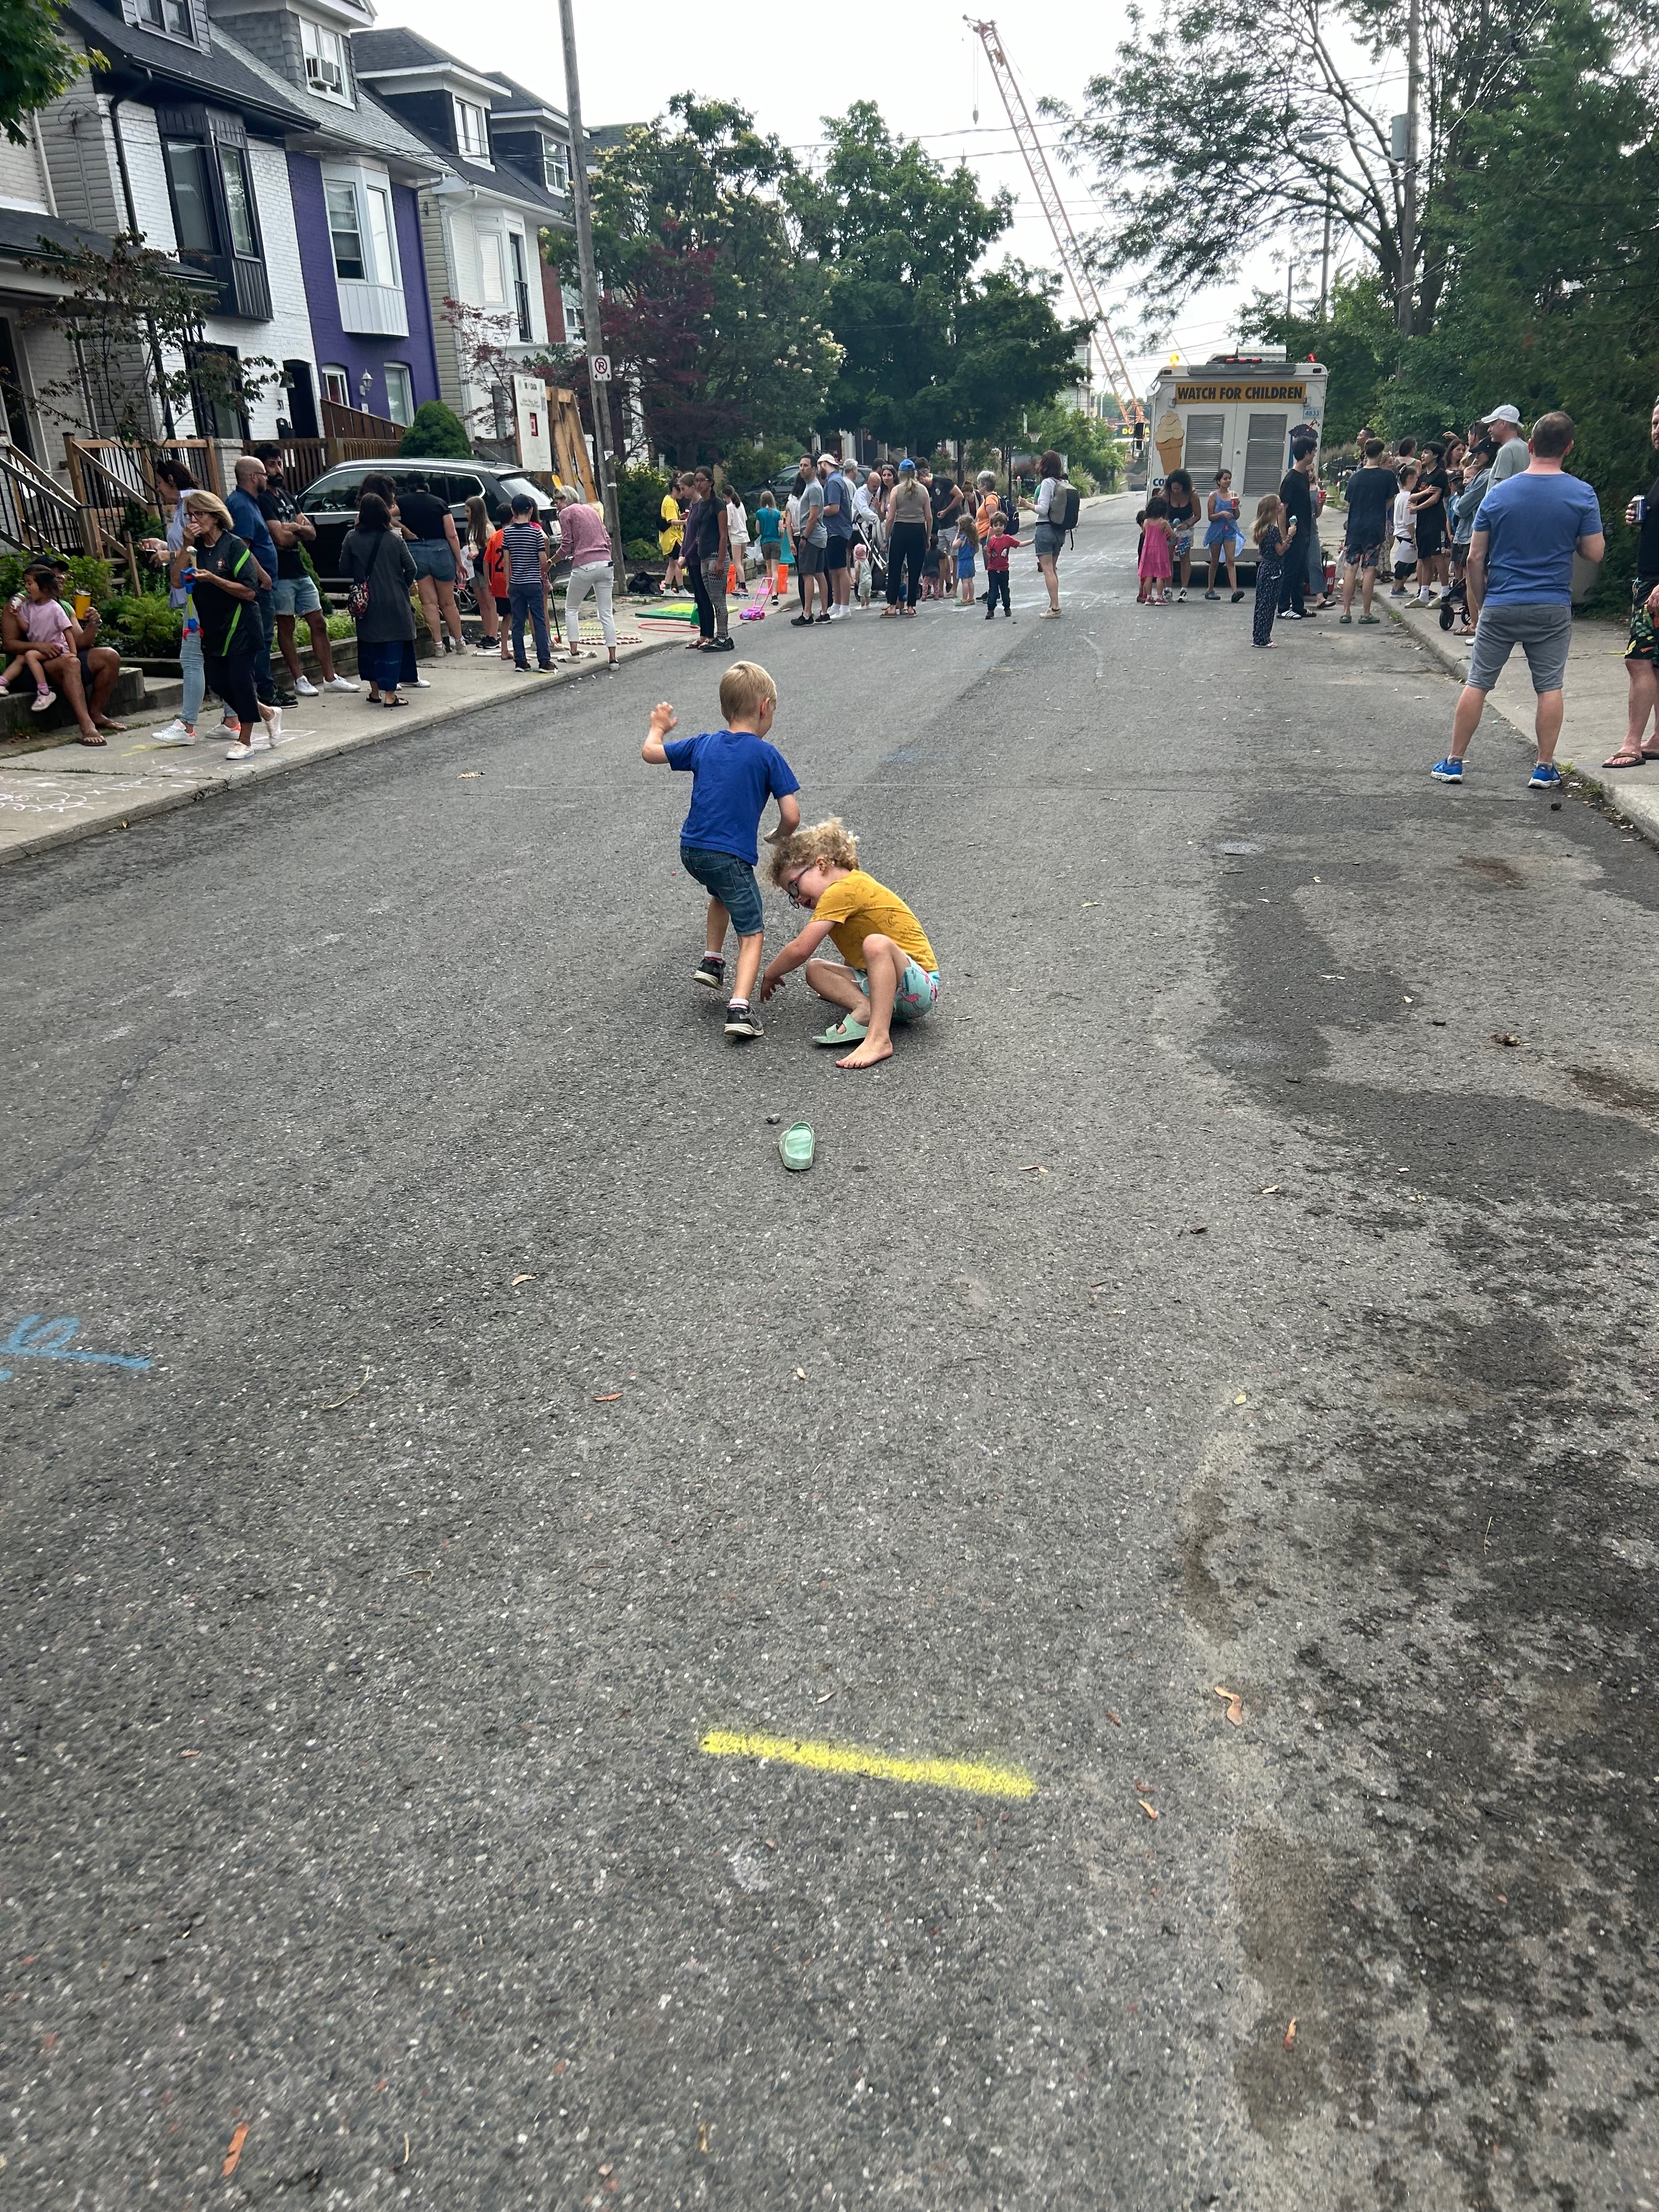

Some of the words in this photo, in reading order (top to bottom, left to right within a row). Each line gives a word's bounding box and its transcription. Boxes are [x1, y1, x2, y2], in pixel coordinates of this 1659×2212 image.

[1177, 387, 1216, 399] WATCH
[1220, 387, 1242, 399] FOR
[1245, 386, 1302, 399] CHILDREN
[495, 548, 504, 572] 2
